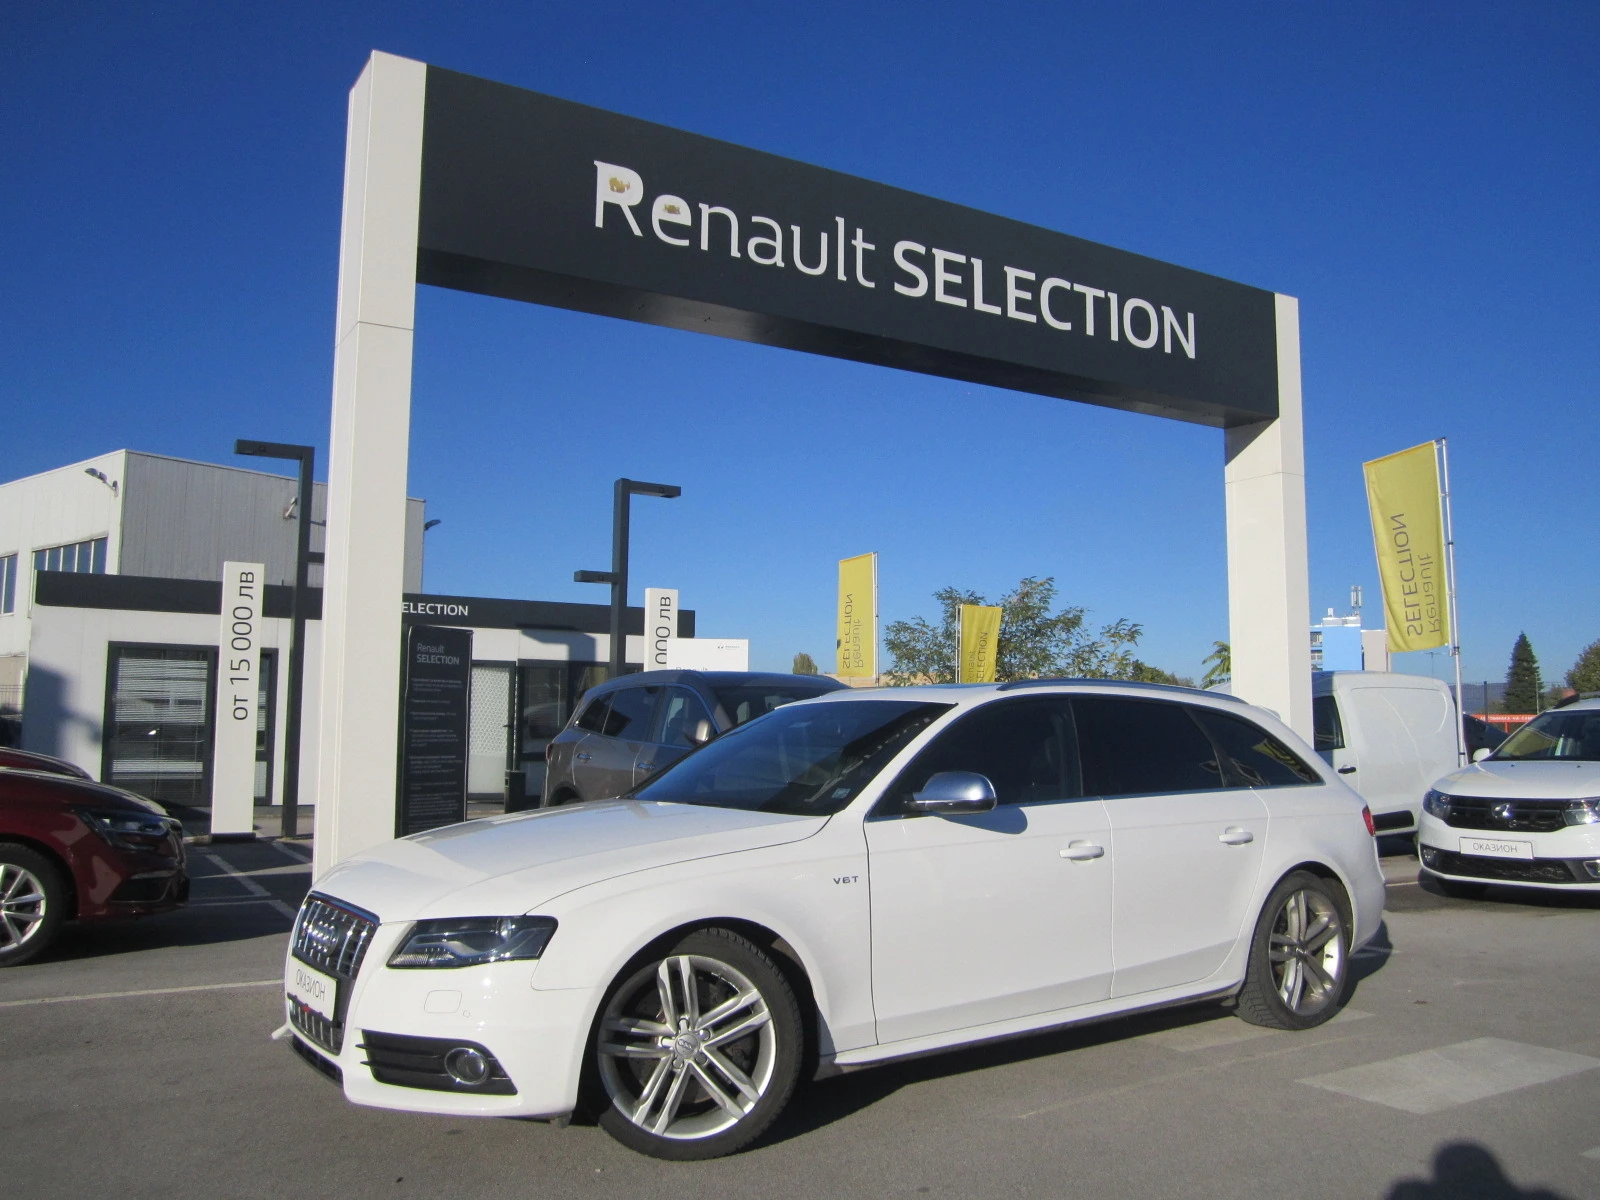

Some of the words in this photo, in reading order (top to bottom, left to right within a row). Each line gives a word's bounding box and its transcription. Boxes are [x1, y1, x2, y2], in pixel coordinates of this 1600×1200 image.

[593, 160, 876, 289] Renault
[893, 240, 1197, 359] SELECTION
[401, 602, 469, 616] ELECTION
[231, 606, 253, 651] 000
[416, 642, 445, 654] Renault
[416, 654, 460, 666] SELECTION
[229, 659, 250, 685] 15
[1472, 842, 1518, 853] ОКАЗИОН
[833, 875, 859, 885] V6T
[295, 968, 326, 1002] ОКАЗИОН
